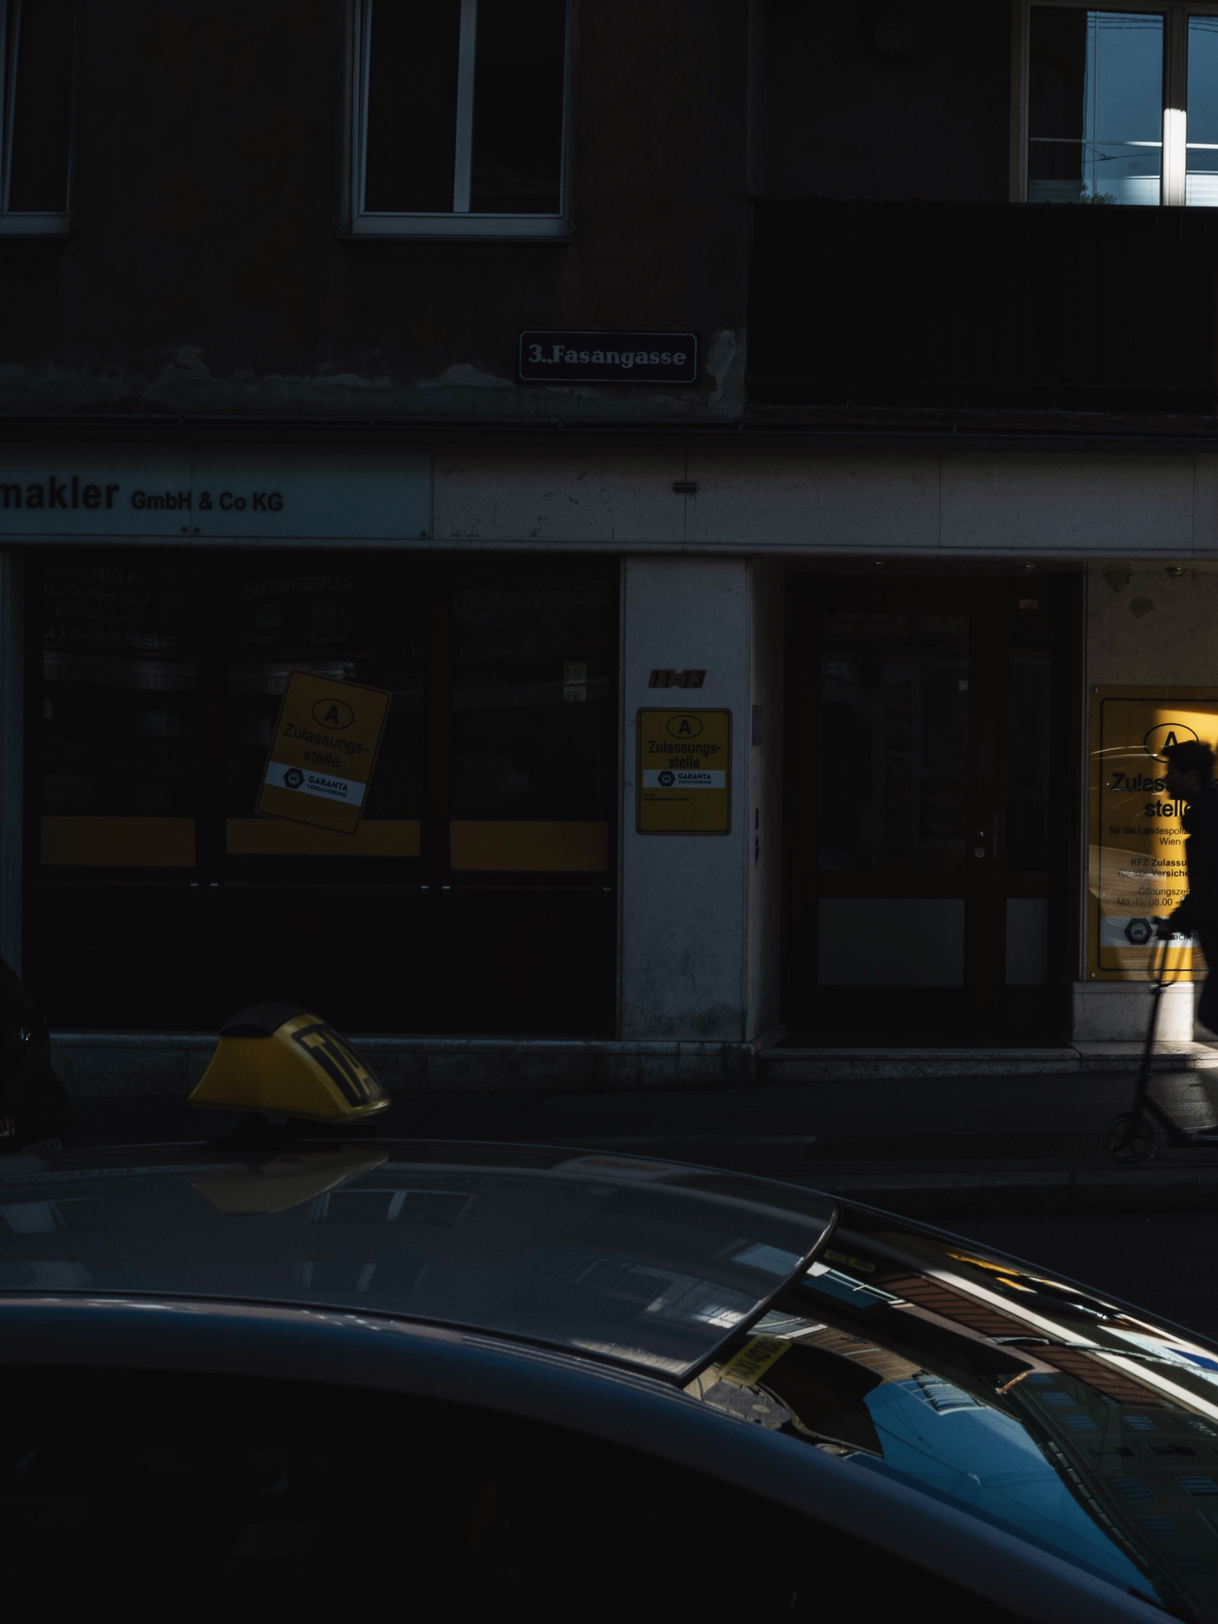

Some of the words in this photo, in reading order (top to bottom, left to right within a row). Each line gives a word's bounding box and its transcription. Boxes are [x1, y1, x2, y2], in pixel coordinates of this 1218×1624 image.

[0, 476, 120, 510] makler
[131, 490, 192, 511] GmbH
[198, 491, 213, 512] &
[219, 491, 246, 513] Co
[252, 491, 284, 513] KG
[652, 670, 706, 688] 11-13
[323, 705, 339, 725] A
[678, 719, 692, 735] A
[282, 722, 370, 756] Zulassungs-
[648, 740, 722, 757] Zulassungs-
[303, 749, 341, 769] stelle
[668, 755, 701, 769] stelle
[306, 783, 347, 798] VERSICHERUNG
[308, 775, 348, 792] GARANTA
[1109, 826, 1121, 835] für
[1123, 826, 1135, 834] die
[1159, 837, 1181, 846] Wien
[1130, 858, 1149, 867] KFZ
[1150, 858, 1187, 867] Zulassu
[1151, 869, 1188, 878] Versiche
[1148, 898, 1173, 906] 08.00
